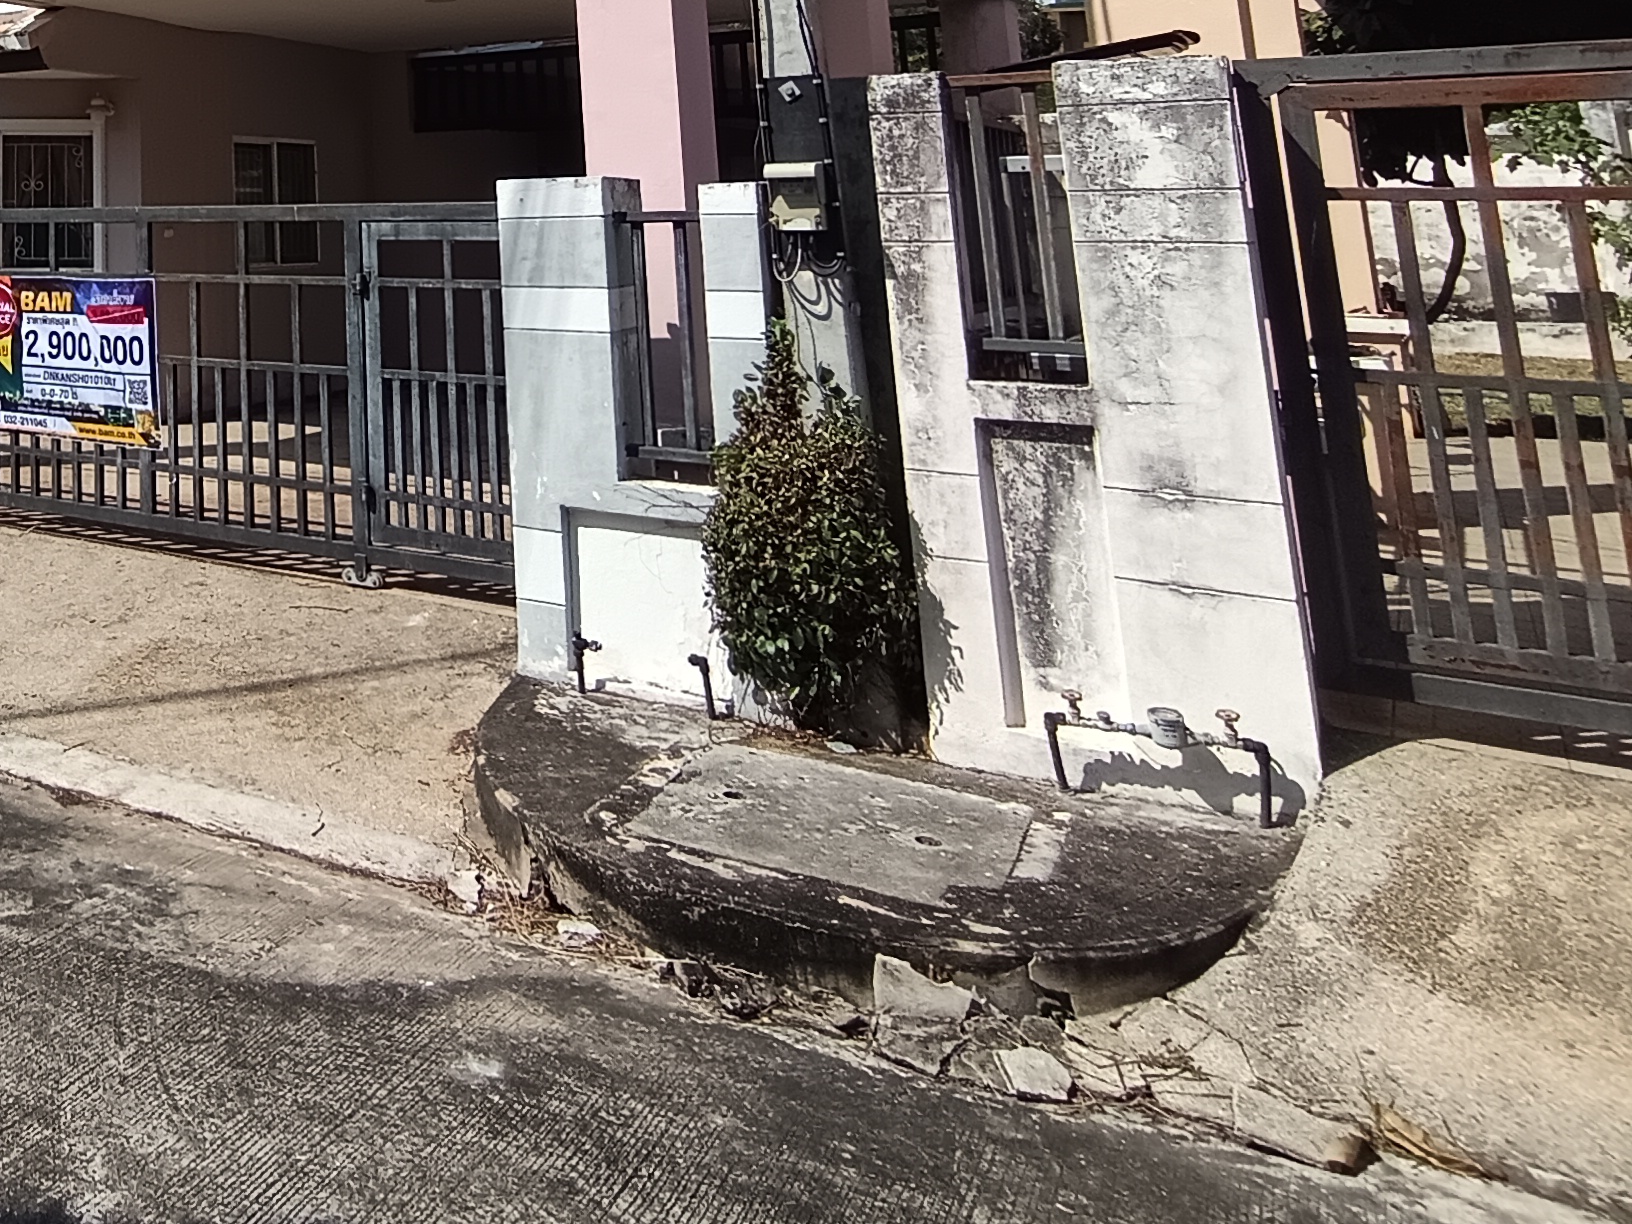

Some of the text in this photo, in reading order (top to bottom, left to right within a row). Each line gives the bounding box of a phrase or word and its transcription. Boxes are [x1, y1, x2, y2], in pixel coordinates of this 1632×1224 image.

[20, 290, 73, 311] BAM
[24, 329, 144, 366] 2,900,000
[78, 426, 136, 440] www.bam.co.th
